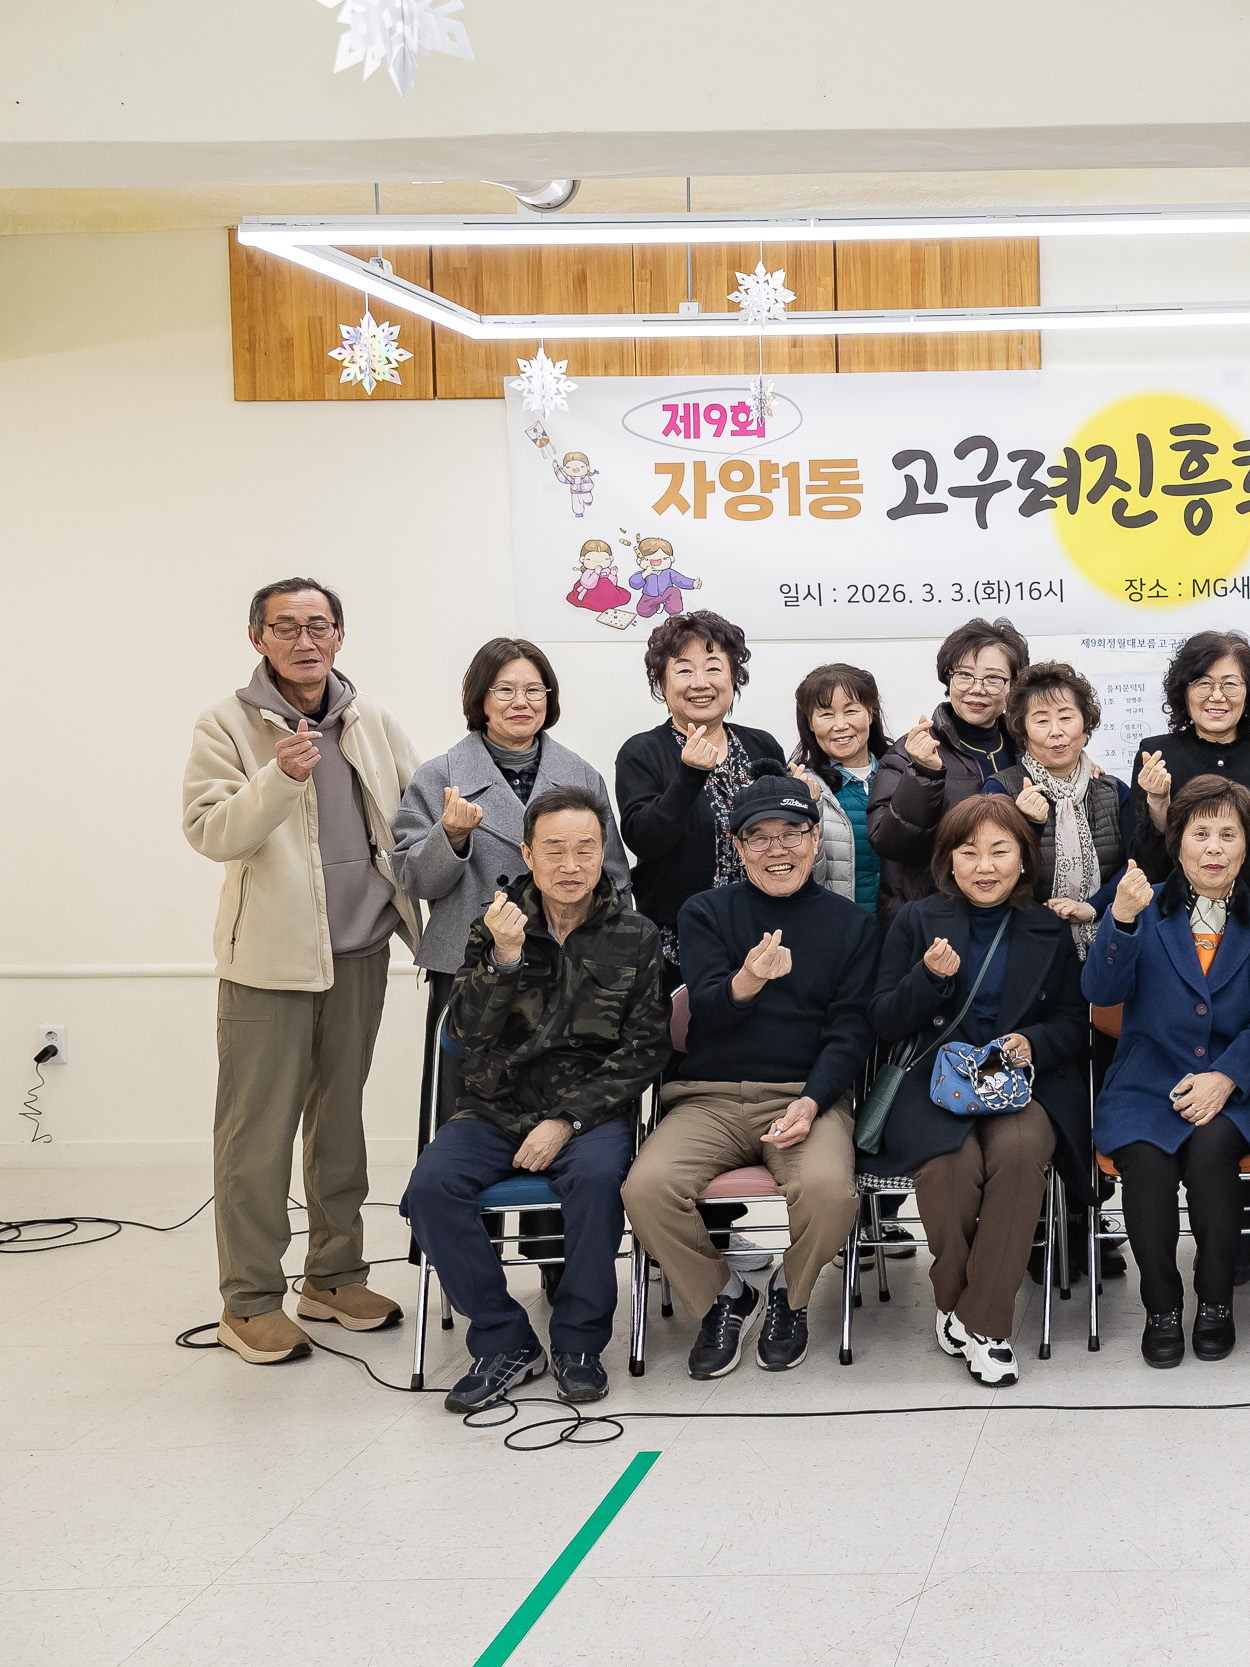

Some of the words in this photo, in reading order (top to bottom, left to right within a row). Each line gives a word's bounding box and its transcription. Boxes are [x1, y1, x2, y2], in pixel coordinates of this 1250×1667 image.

[662, 401, 766, 439] 제9회
[653, 458, 863, 521] 자양1동
[780, 583, 822, 607] 일시
[847, 584, 912, 603] 2026.
[922, 584, 942, 603] 3.
[1124, 578, 1169, 601] 장소
[1107, 683, 1145, 693] 을지문덕팀
[1105, 749, 1117, 757] 3조
